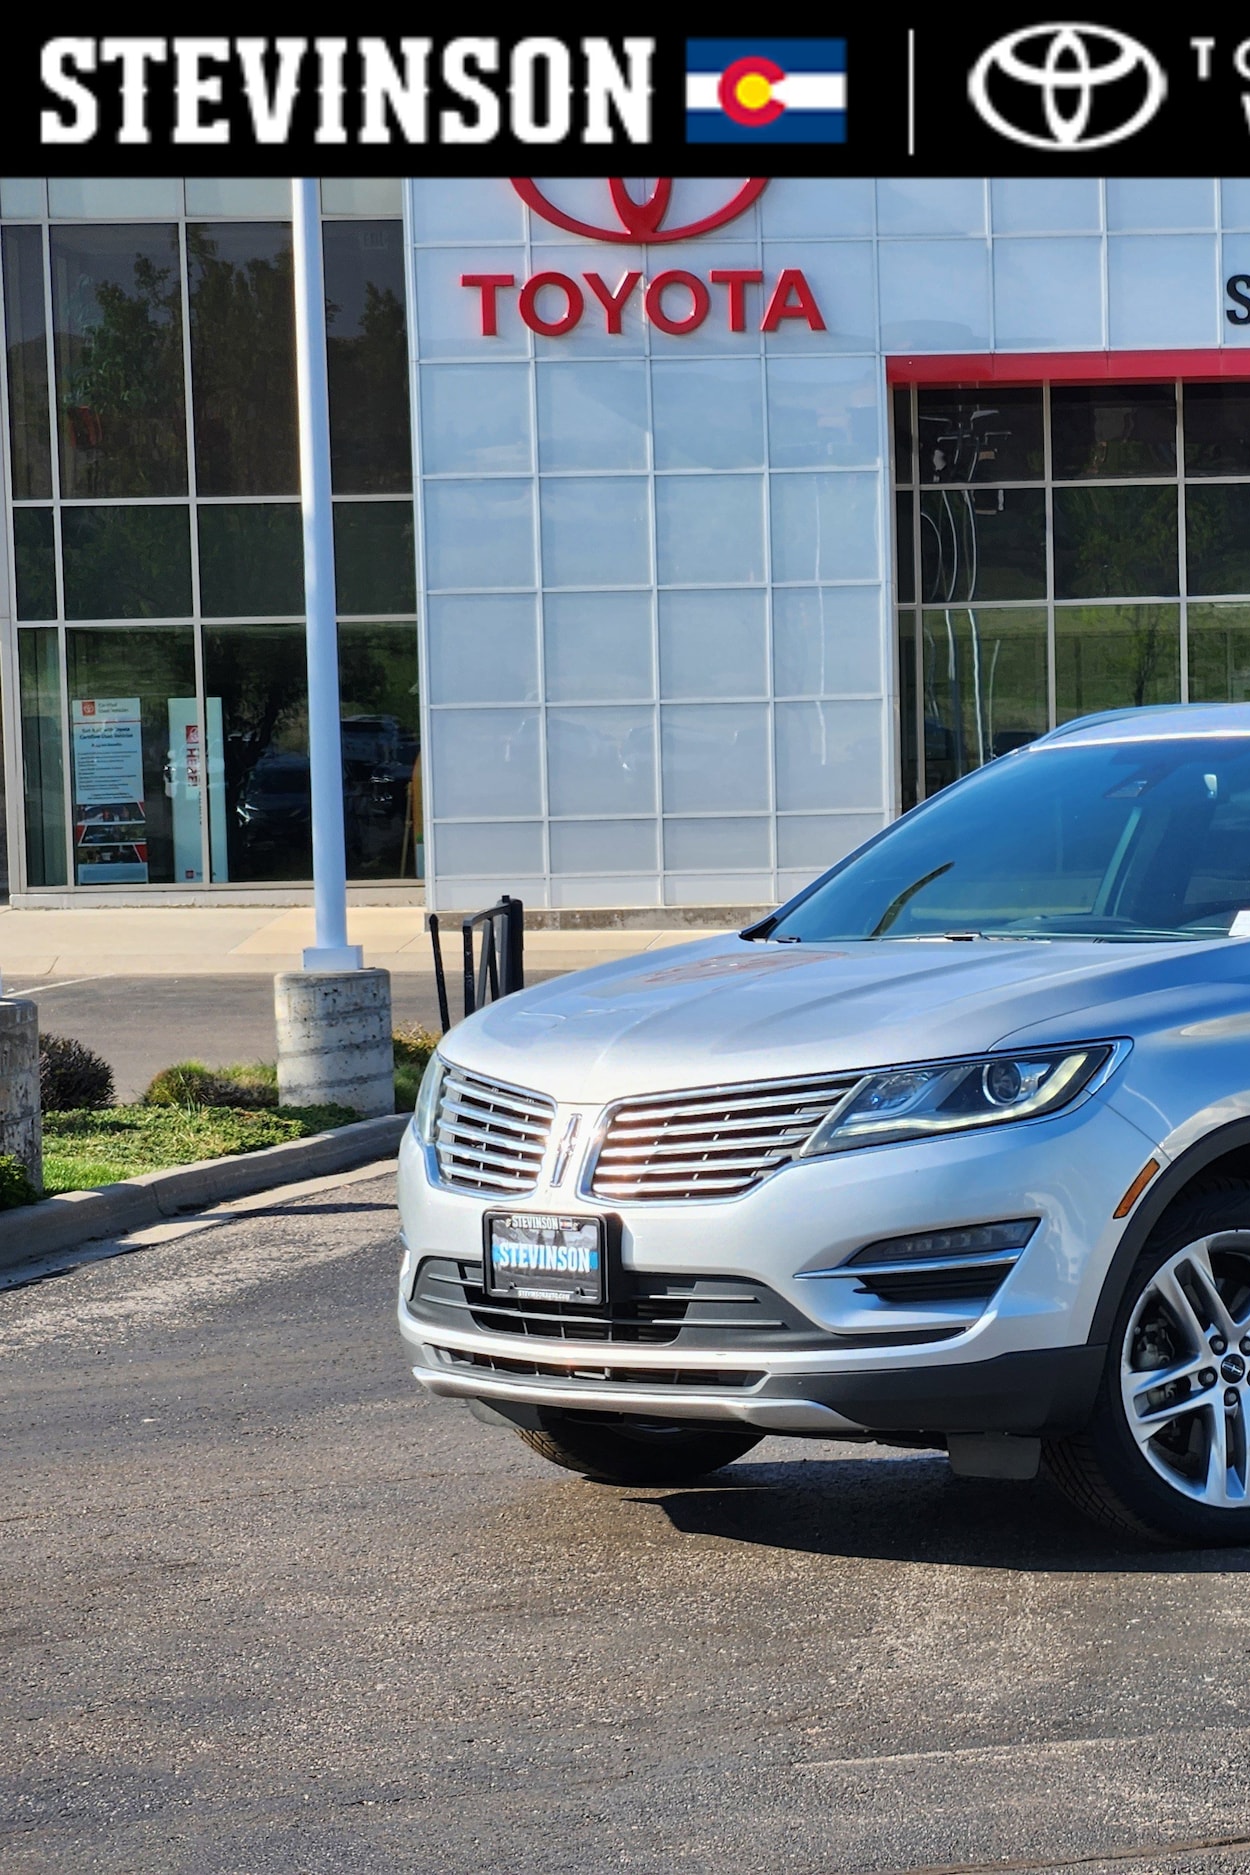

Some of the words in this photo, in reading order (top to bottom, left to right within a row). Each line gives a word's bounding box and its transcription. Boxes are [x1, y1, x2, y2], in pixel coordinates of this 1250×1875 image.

[461, 269, 826, 337] TOYOTA
[512, 1215, 559, 1230] STEVINSON
[500, 1242, 591, 1273] STEVINSON
